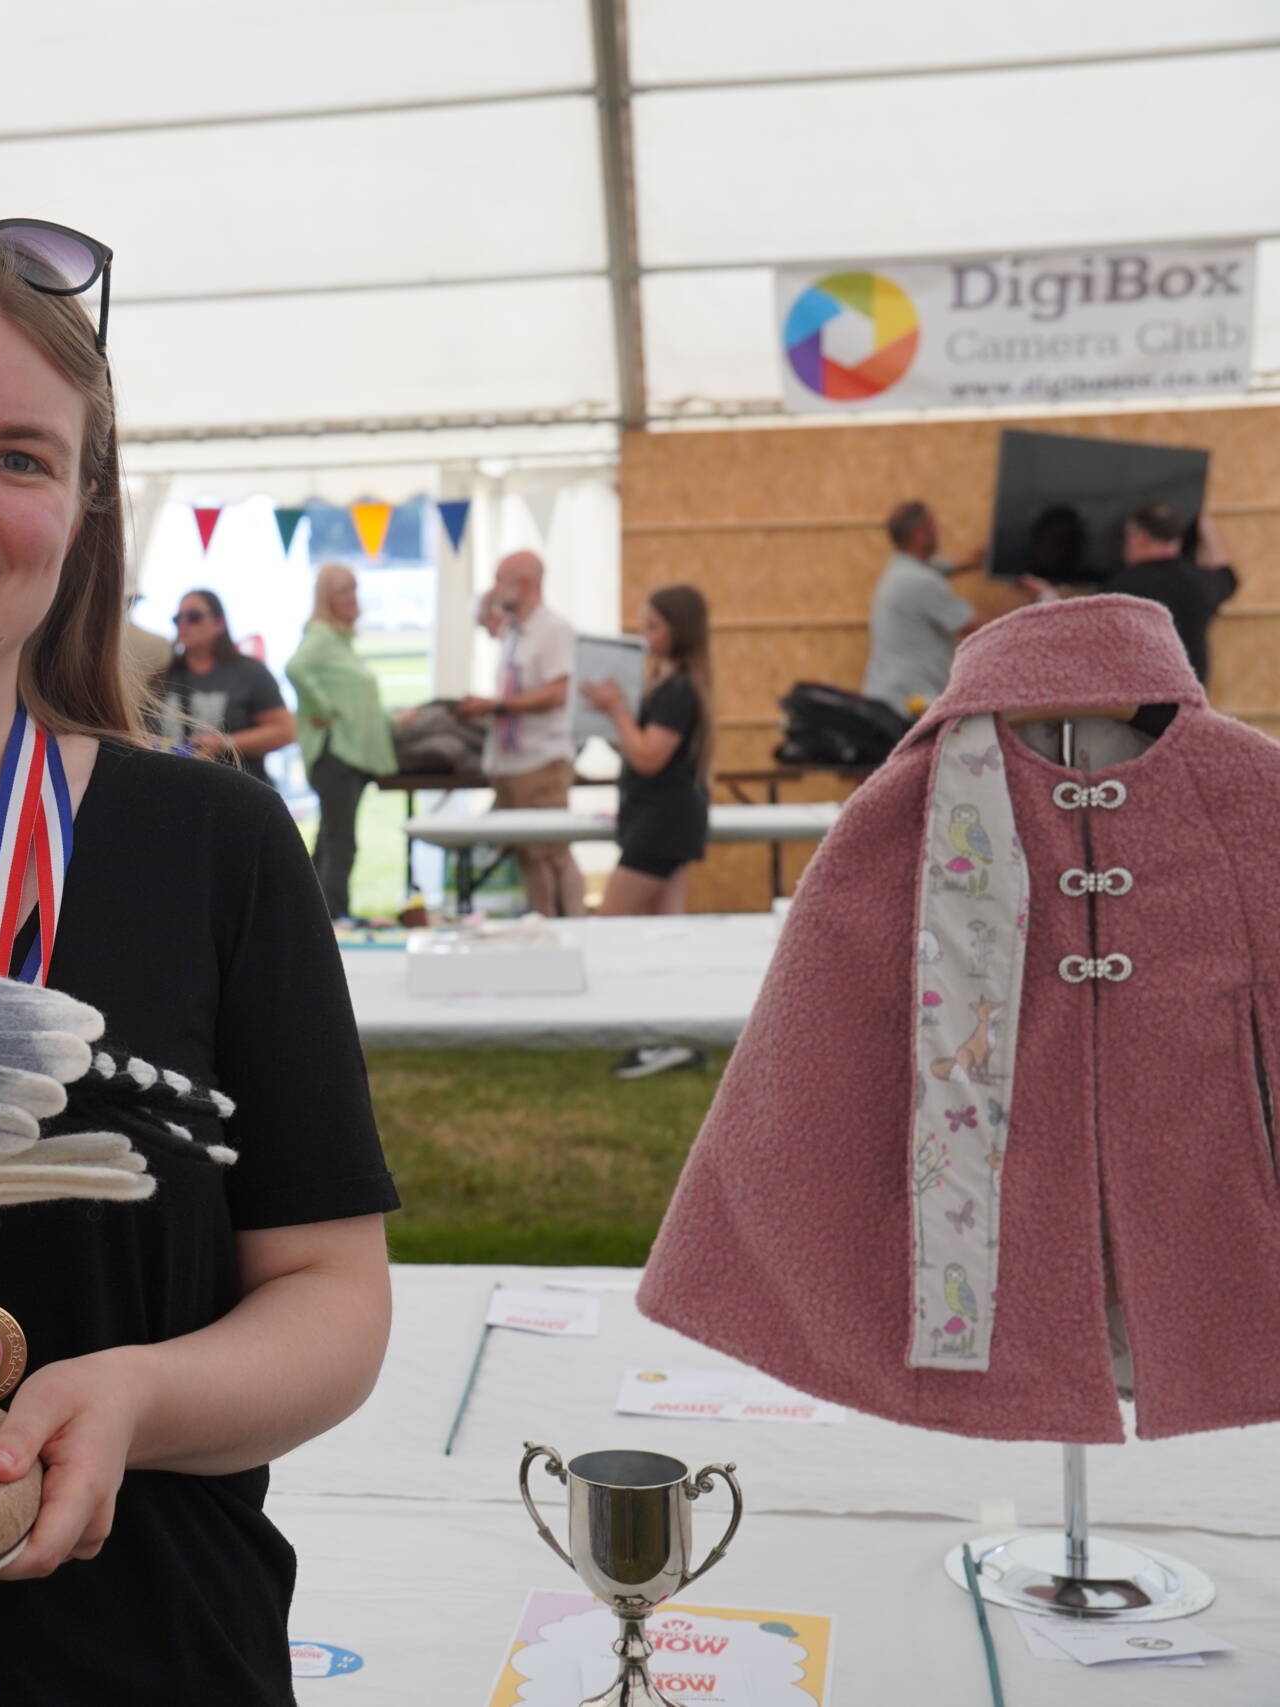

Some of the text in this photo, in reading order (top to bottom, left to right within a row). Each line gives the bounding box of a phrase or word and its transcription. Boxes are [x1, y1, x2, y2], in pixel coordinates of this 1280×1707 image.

[950, 255, 1242, 320] DigiBox
[946, 316, 1246, 364] Camera Club
